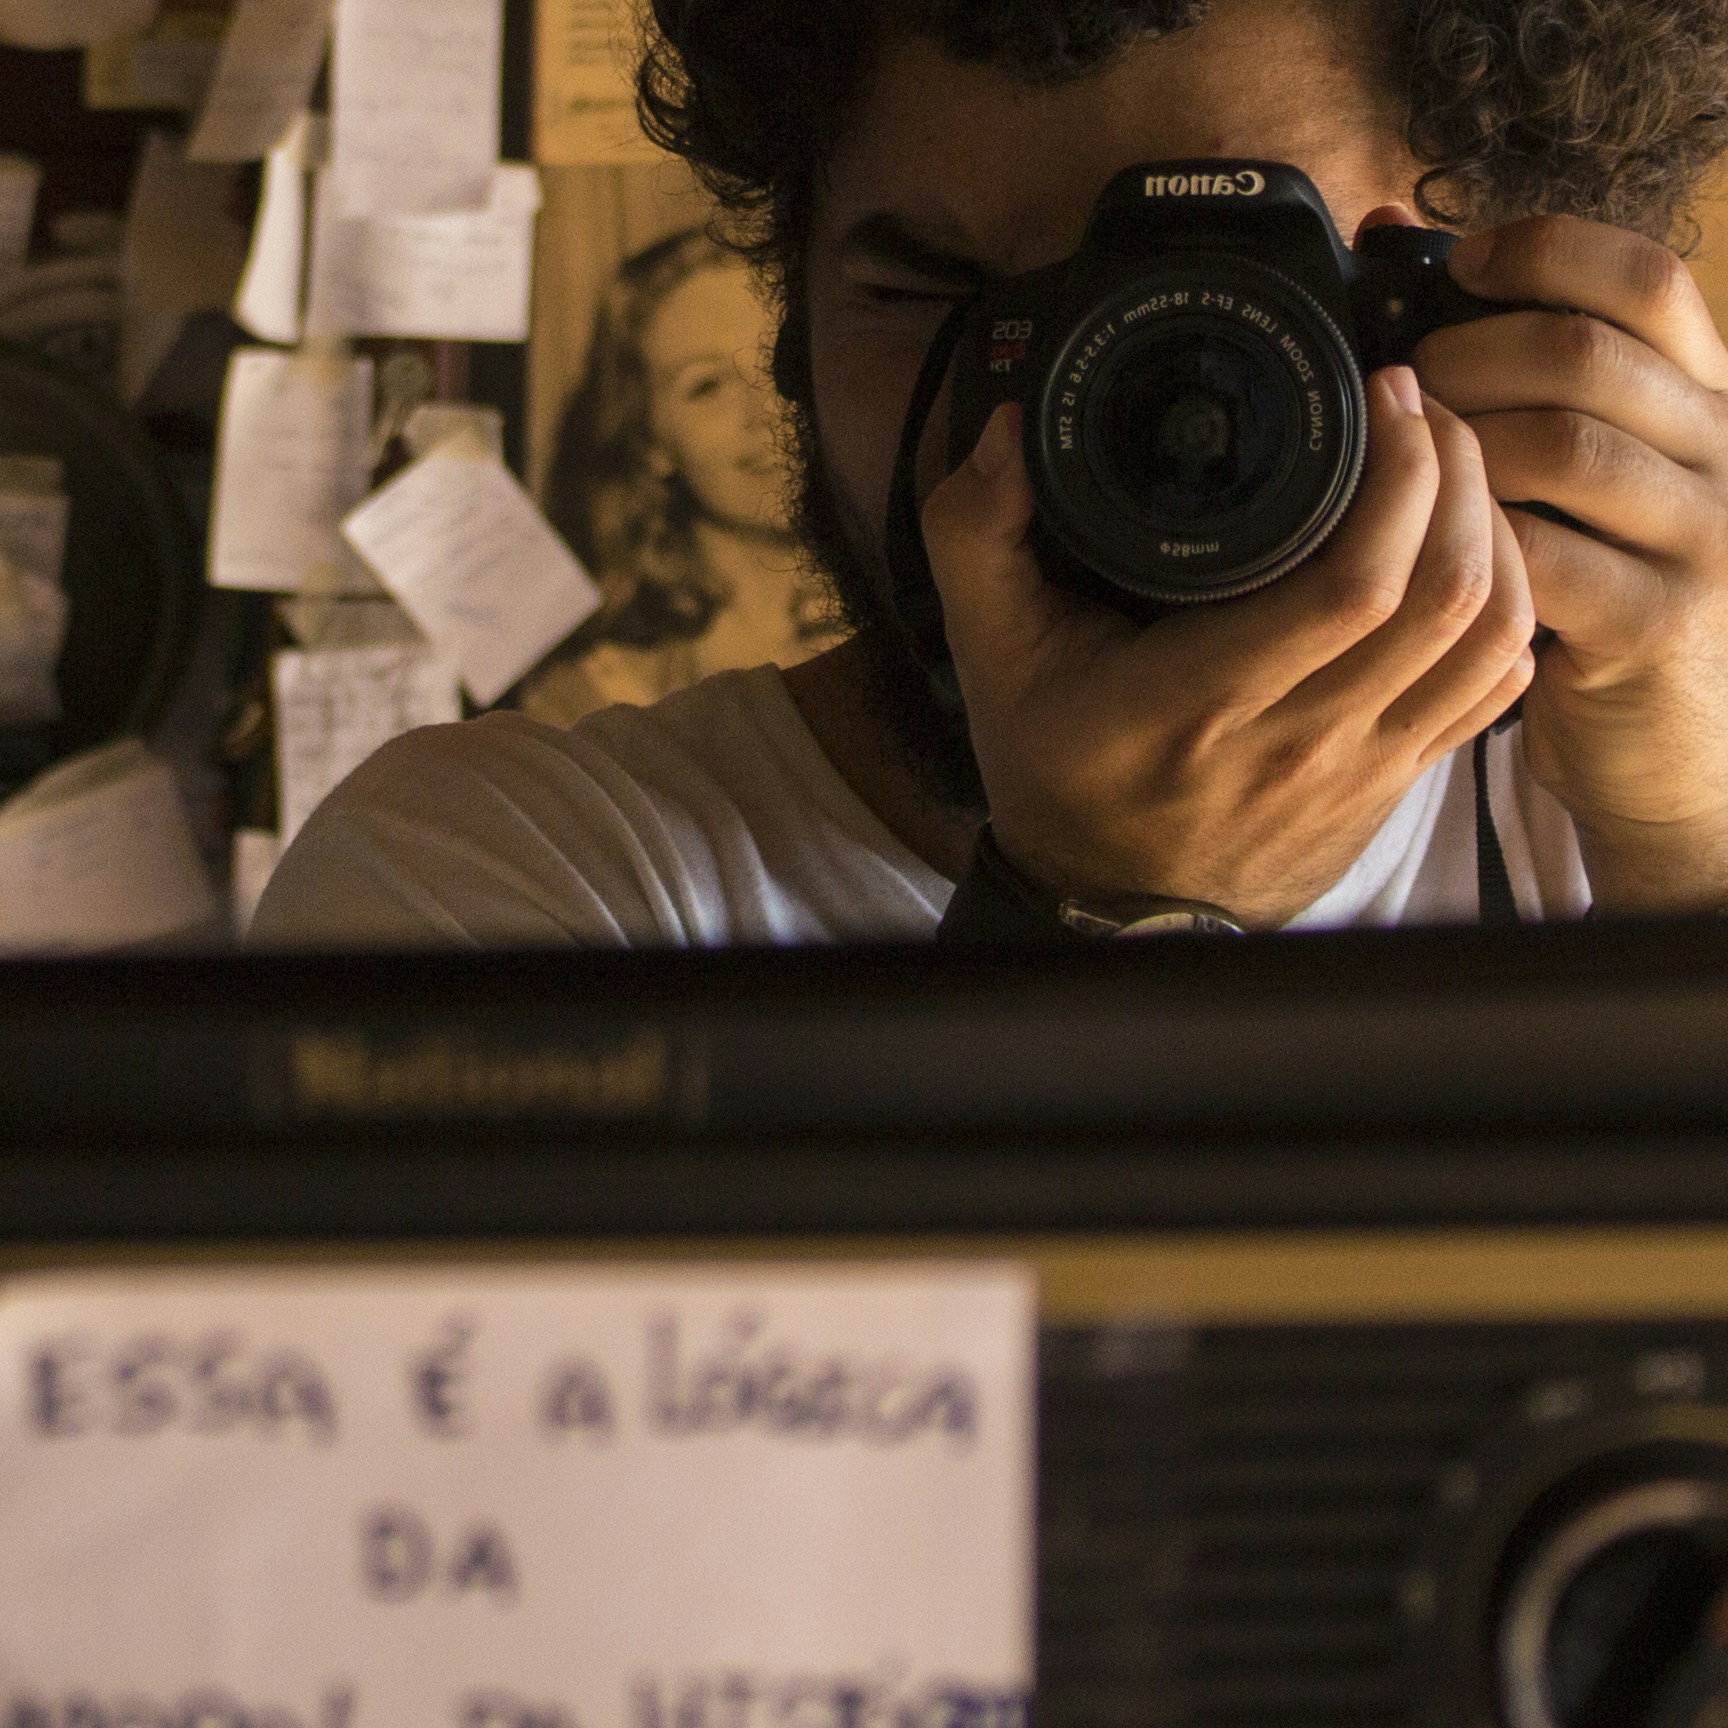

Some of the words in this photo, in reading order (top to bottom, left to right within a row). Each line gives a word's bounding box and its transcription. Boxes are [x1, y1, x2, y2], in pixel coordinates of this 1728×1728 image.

[27, 1327, 339, 1450] ESSA
[408, 1308, 479, 1444] É
[357, 1498, 523, 1610] DA
